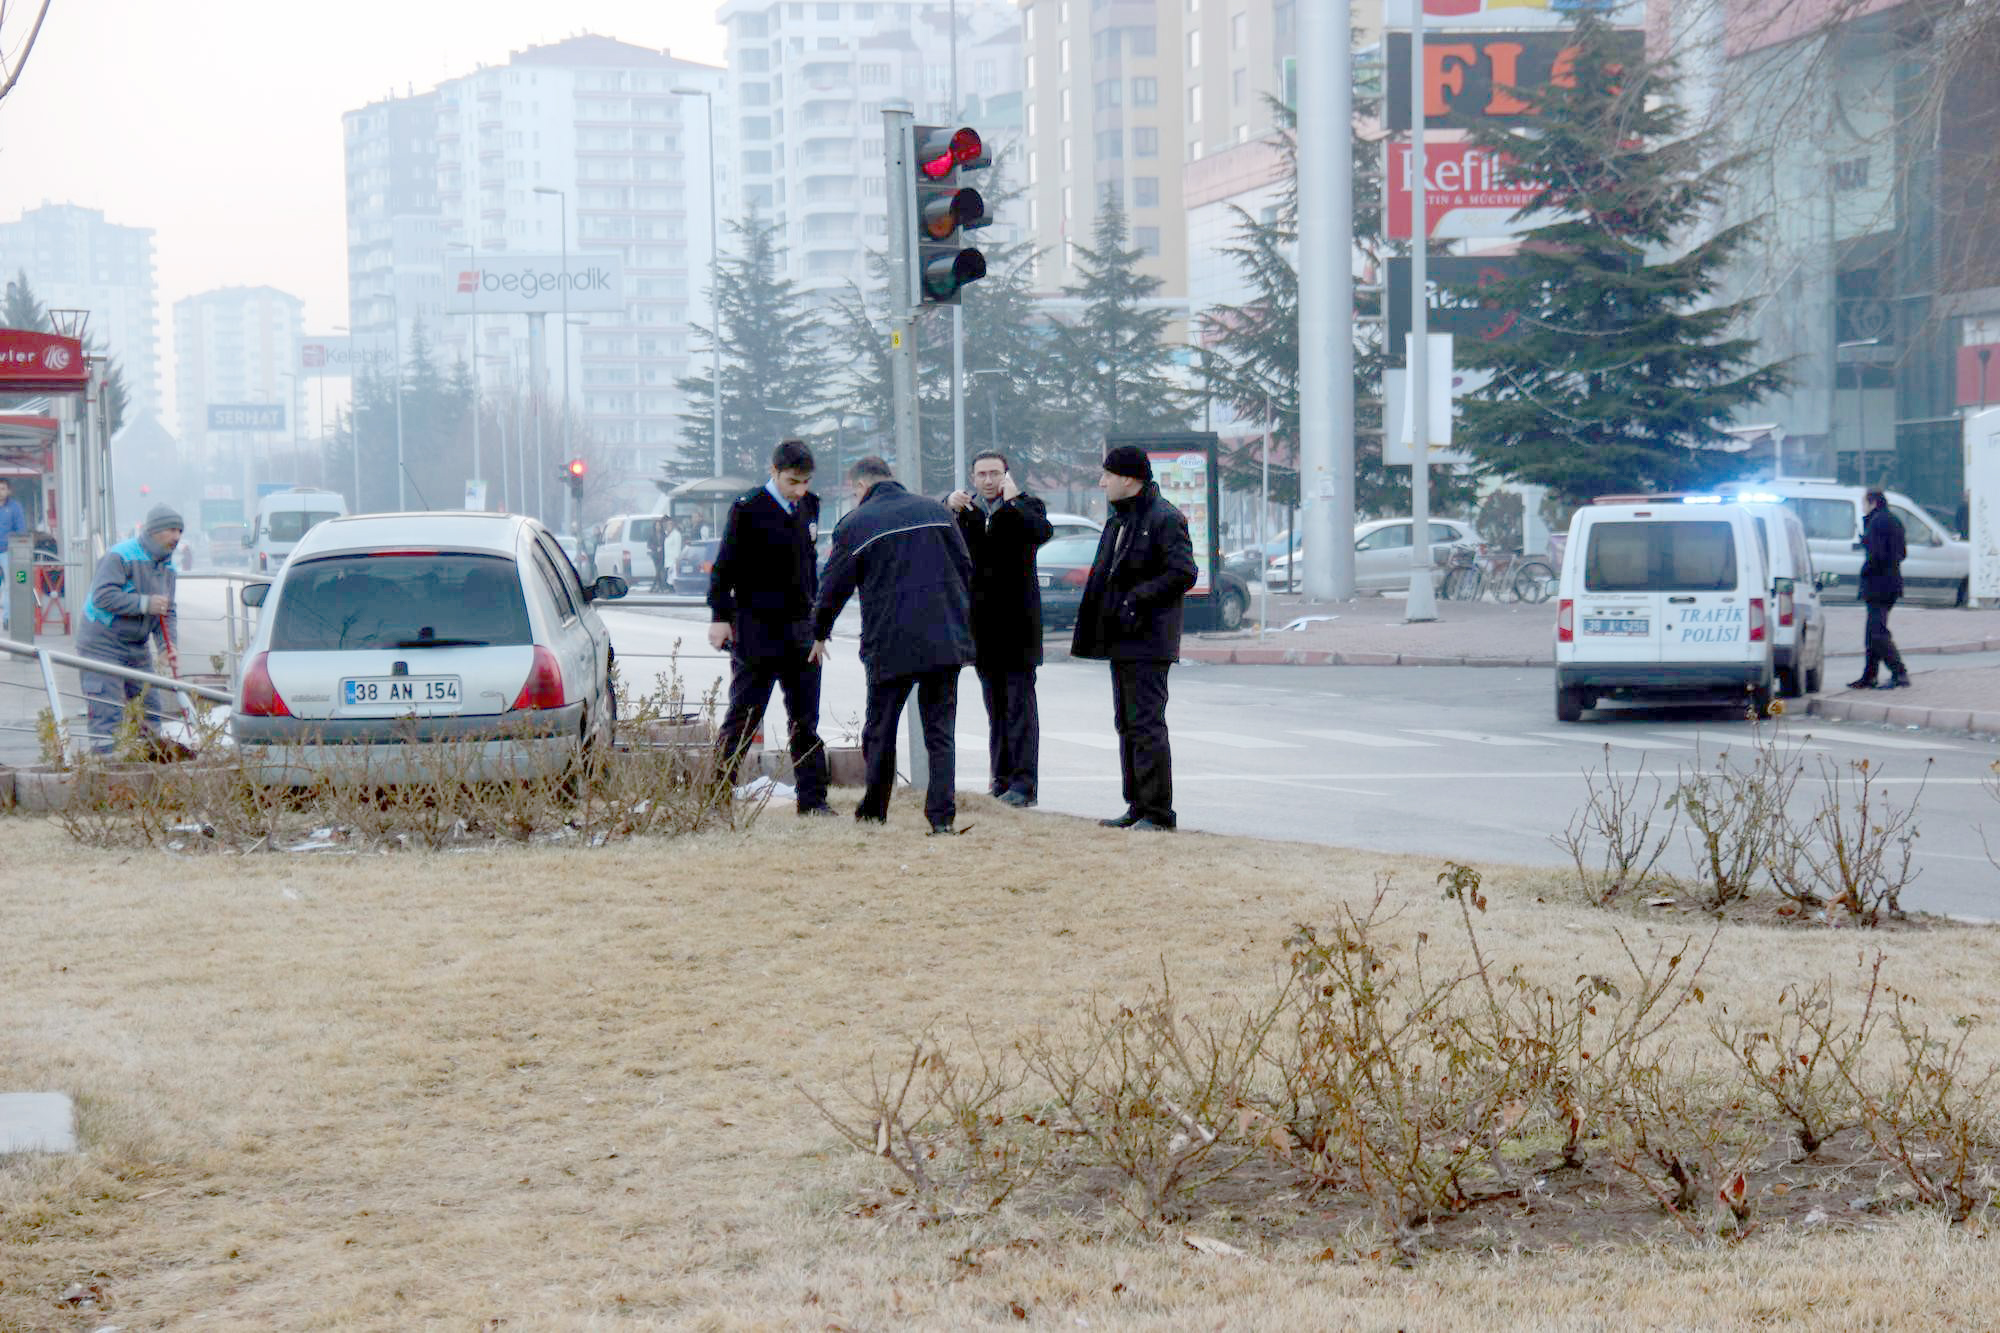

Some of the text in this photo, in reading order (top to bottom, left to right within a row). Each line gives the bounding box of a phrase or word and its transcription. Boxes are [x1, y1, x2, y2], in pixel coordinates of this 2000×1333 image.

[482, 267, 611, 299] beğendik
[326, 347, 394, 363] Kelebek
[215, 410, 279, 424] SERHAT
[1679, 606, 1745, 623] TRAFİK
[1681, 625, 1741, 643] POLİSİ
[356, 682, 457, 700] 38 AN 154
